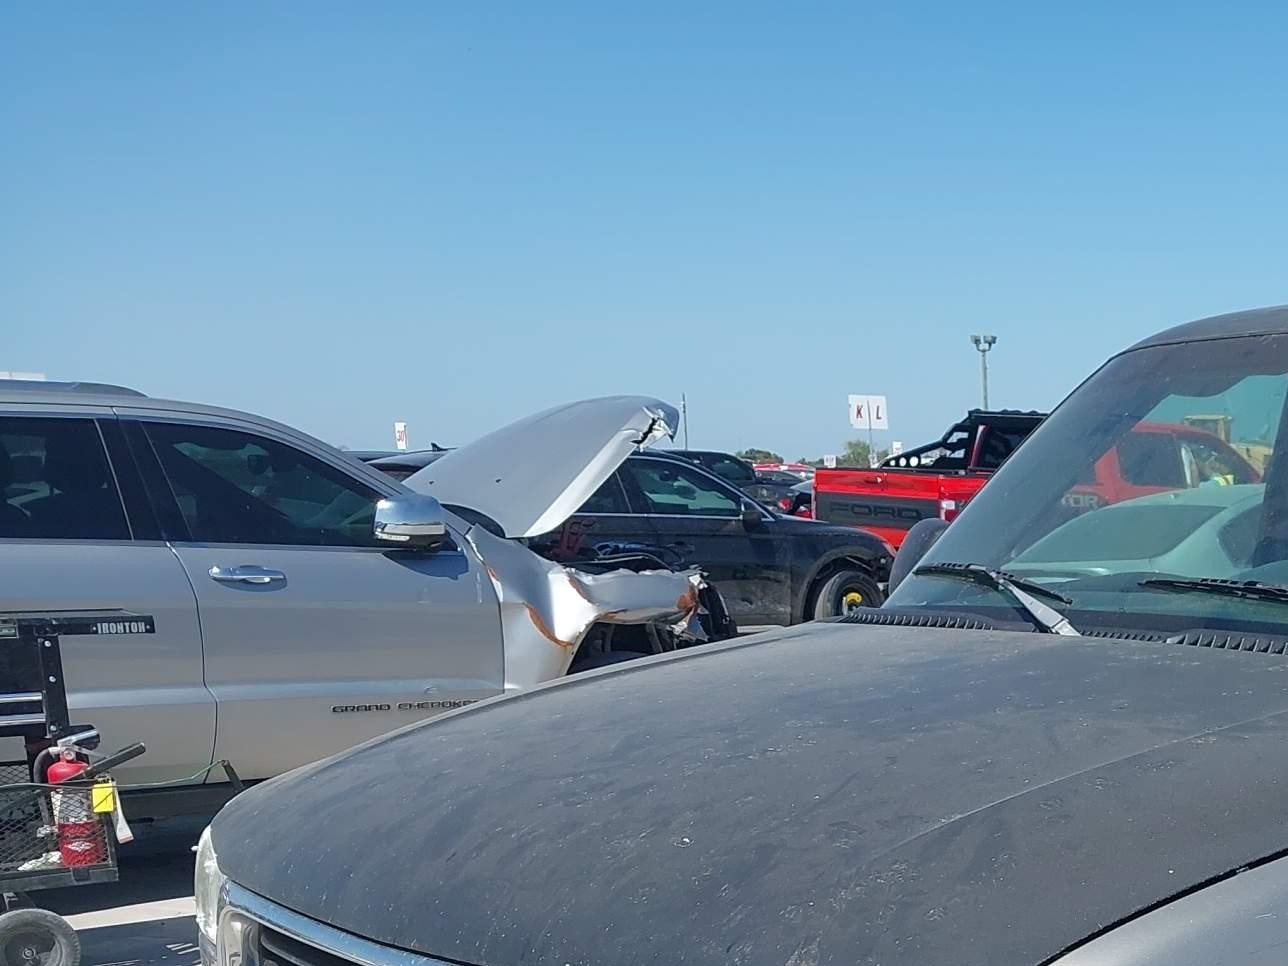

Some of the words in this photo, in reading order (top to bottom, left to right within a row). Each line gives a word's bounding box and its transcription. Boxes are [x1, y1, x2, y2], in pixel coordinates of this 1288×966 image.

[856, 404, 864, 419] K
[830, 501, 922, 519] FORD
[97, 622, 146, 634] IRONTON
[331, 703, 391, 713] GRAND
